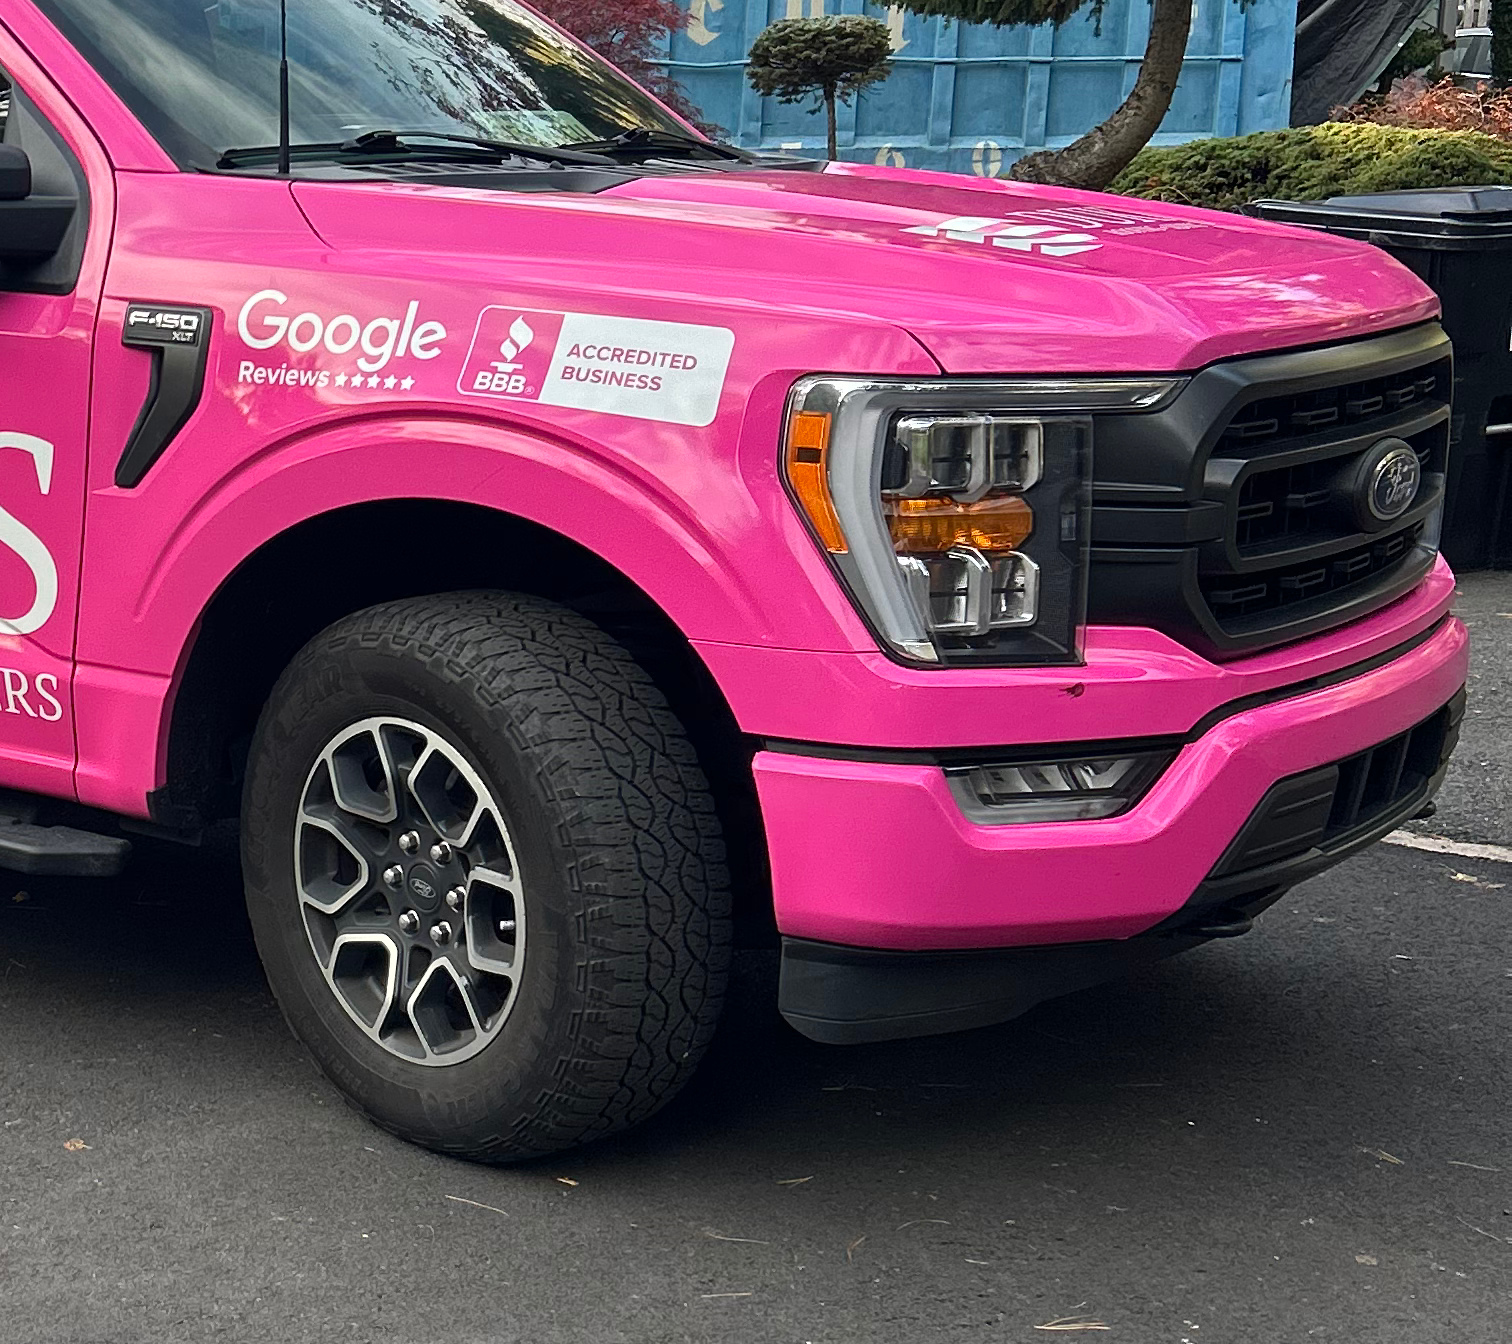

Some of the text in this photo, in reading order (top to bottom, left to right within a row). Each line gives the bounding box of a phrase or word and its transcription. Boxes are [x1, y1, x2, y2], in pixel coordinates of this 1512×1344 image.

[128, 310, 199, 331] F-150
[236, 289, 448, 373] Google
[172, 330, 195, 343] XLT
[566, 343, 698, 372] ACCREDITED
[237, 360, 330, 389] Reviews
[560, 364, 664, 393] BUSINESS
